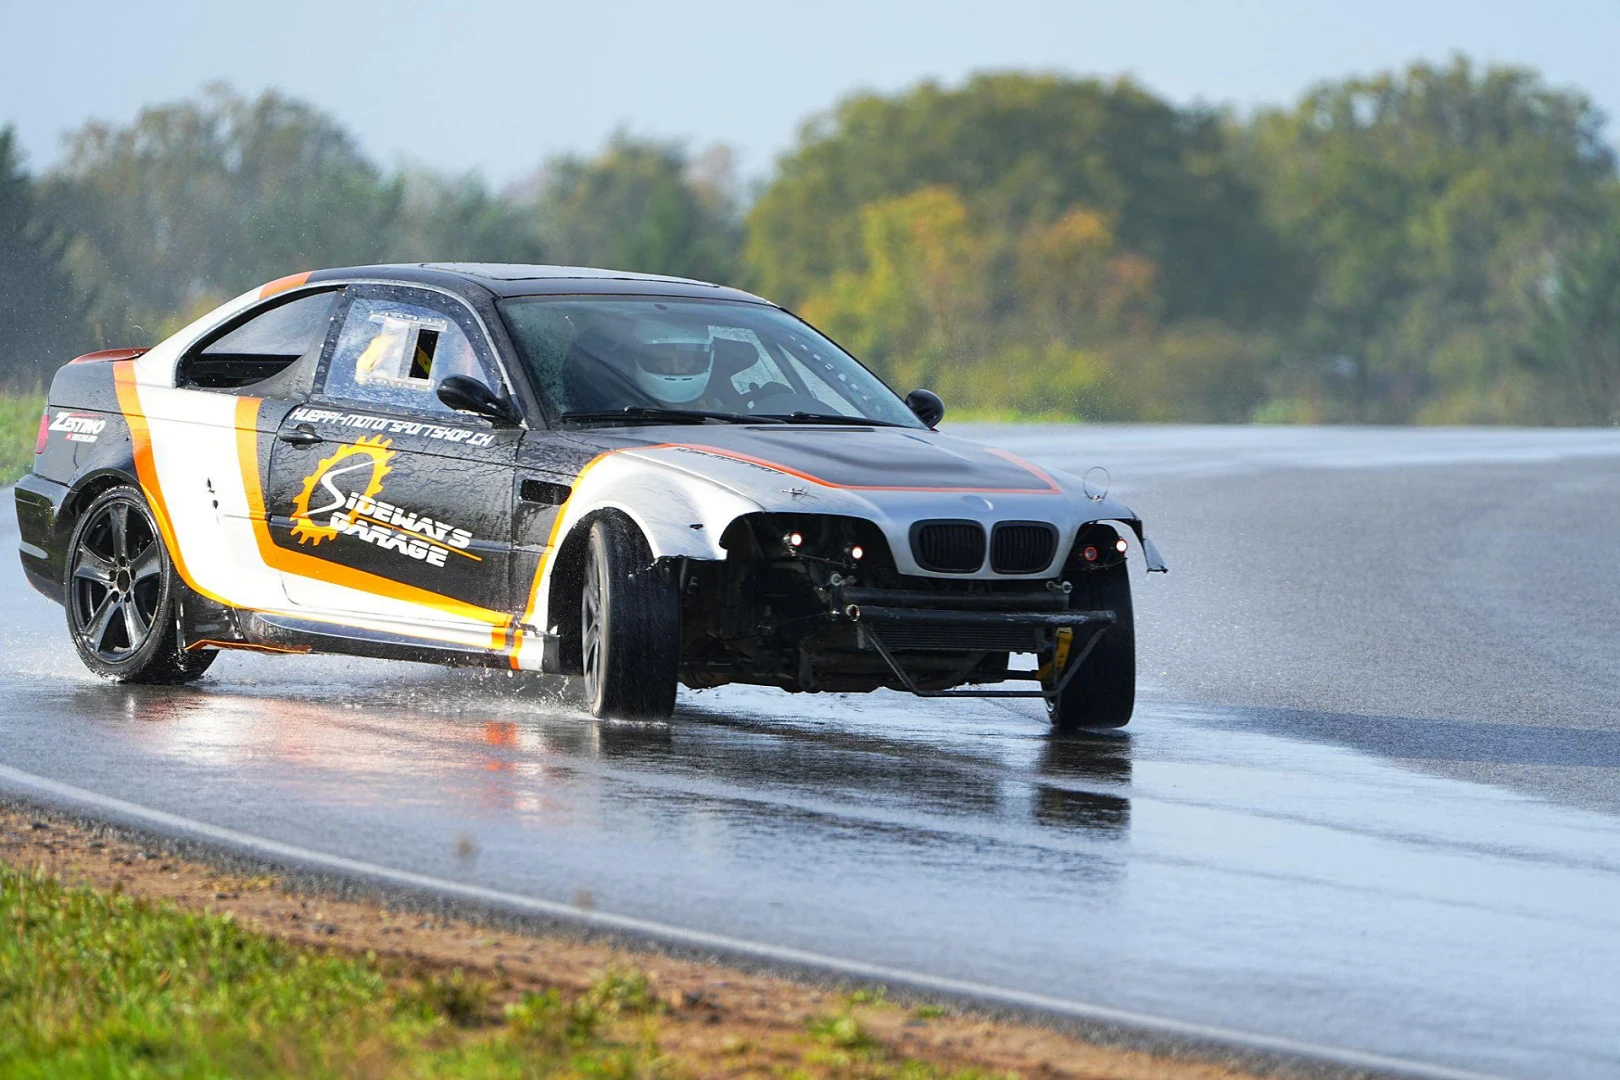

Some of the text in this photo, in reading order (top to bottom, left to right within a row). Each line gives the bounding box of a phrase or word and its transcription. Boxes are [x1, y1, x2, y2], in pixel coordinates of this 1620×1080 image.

[48, 411, 106, 435] ZESTINO
[300, 459, 473, 549] SIDEWAYS
[329, 511, 450, 568] GARAGE
